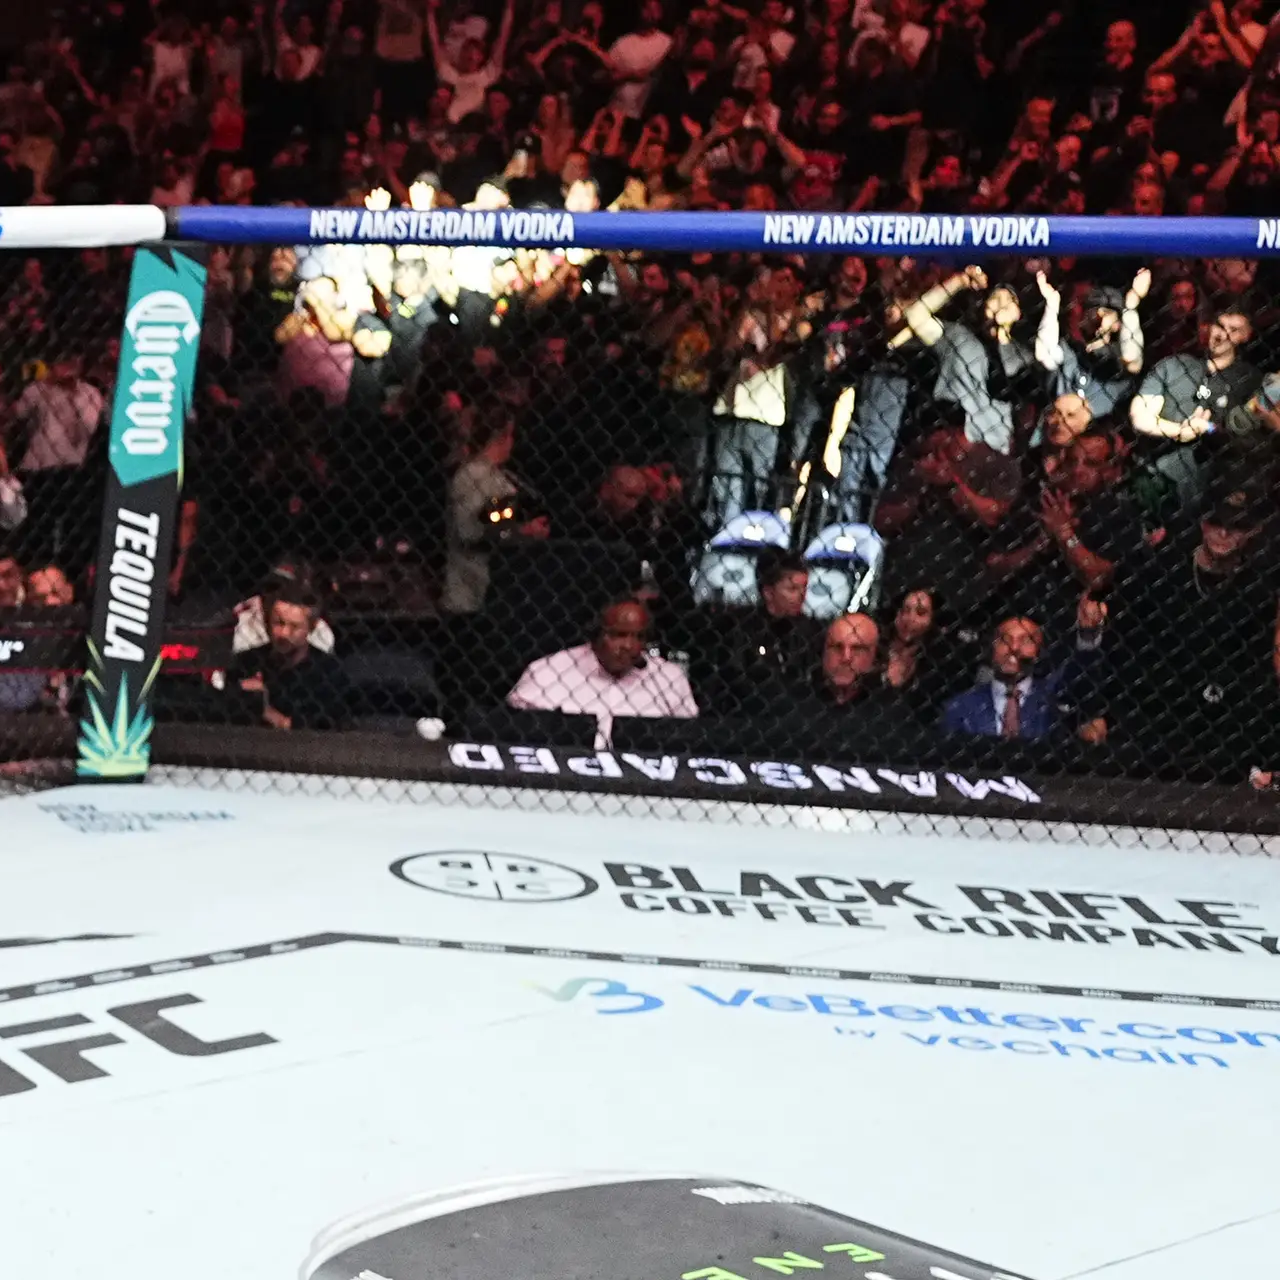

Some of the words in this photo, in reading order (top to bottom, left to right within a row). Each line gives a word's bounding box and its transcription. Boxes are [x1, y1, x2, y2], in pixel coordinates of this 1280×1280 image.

[310, 211, 354, 240] NEW
[359, 211, 494, 242] AMSTERDAM
[499, 212, 575, 242] VODKA
[764, 215, 819, 244] NEW
[817, 216, 964, 246] AMSTERDAM
[969, 217, 1050, 246] VODKA
[122, 290, 201, 456] Cuervo
[104, 508, 160, 663] TEQUILA
[602, 862, 940, 910] BLACK
[957, 885, 1265, 931] RIFLE
[621, 894, 885, 930] COFFEE
[914, 913, 1280, 955] COMPANY
[902, 1032, 1230, 1068] vechain
